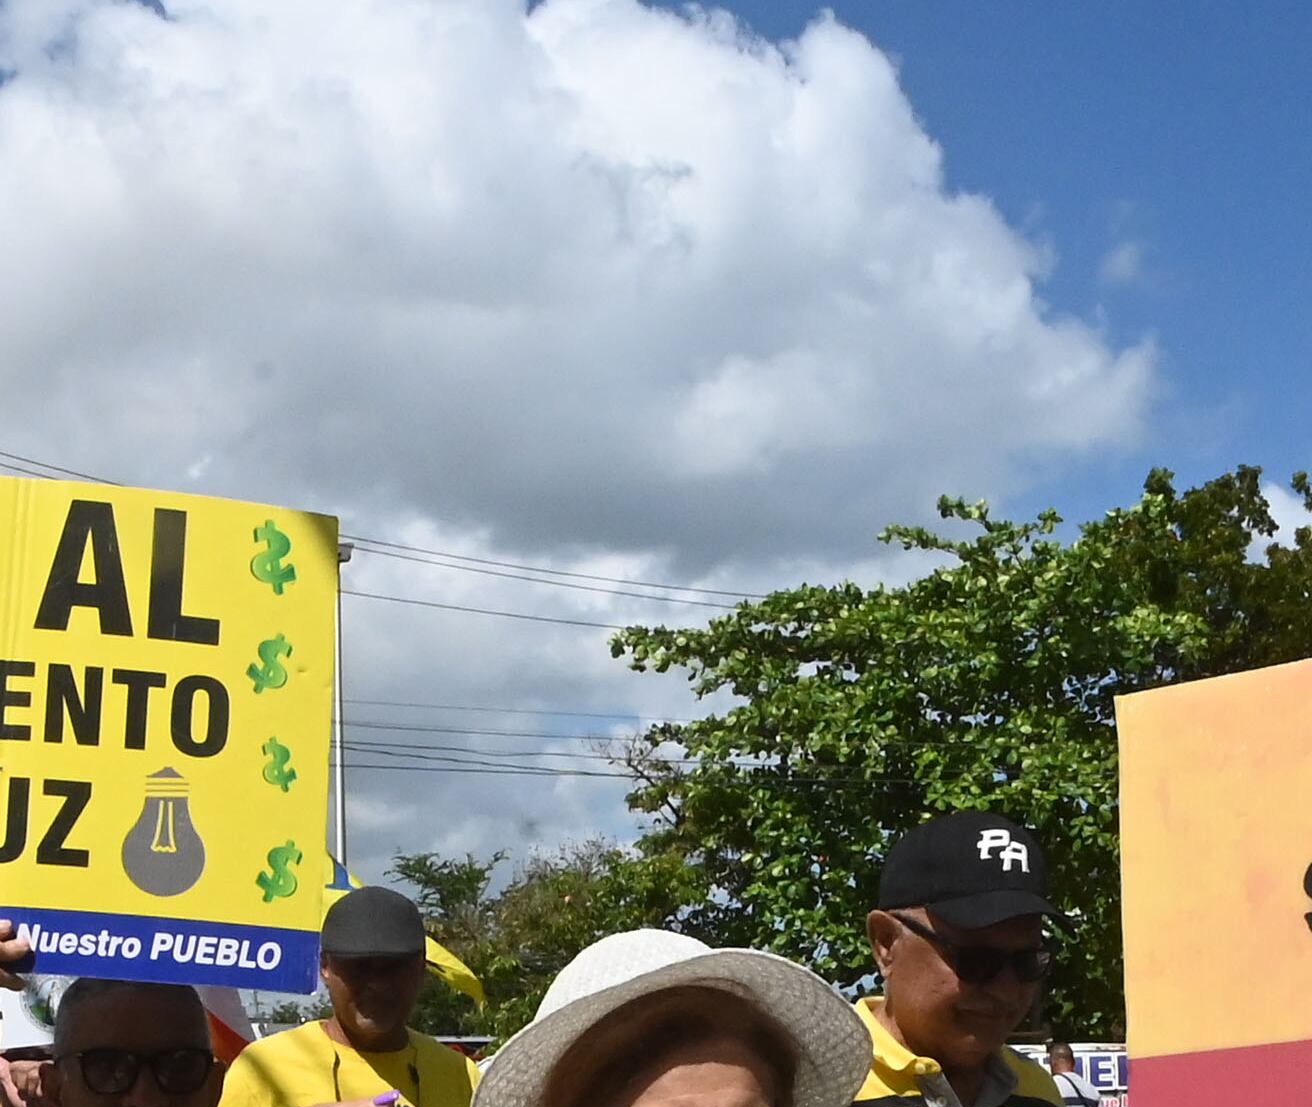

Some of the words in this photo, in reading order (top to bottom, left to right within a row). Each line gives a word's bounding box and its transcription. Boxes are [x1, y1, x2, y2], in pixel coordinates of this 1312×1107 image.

[34, 500, 219, 645] AL
[16, 923, 141, 959] Nuestro
[150, 933, 282, 971] PUEBLO
